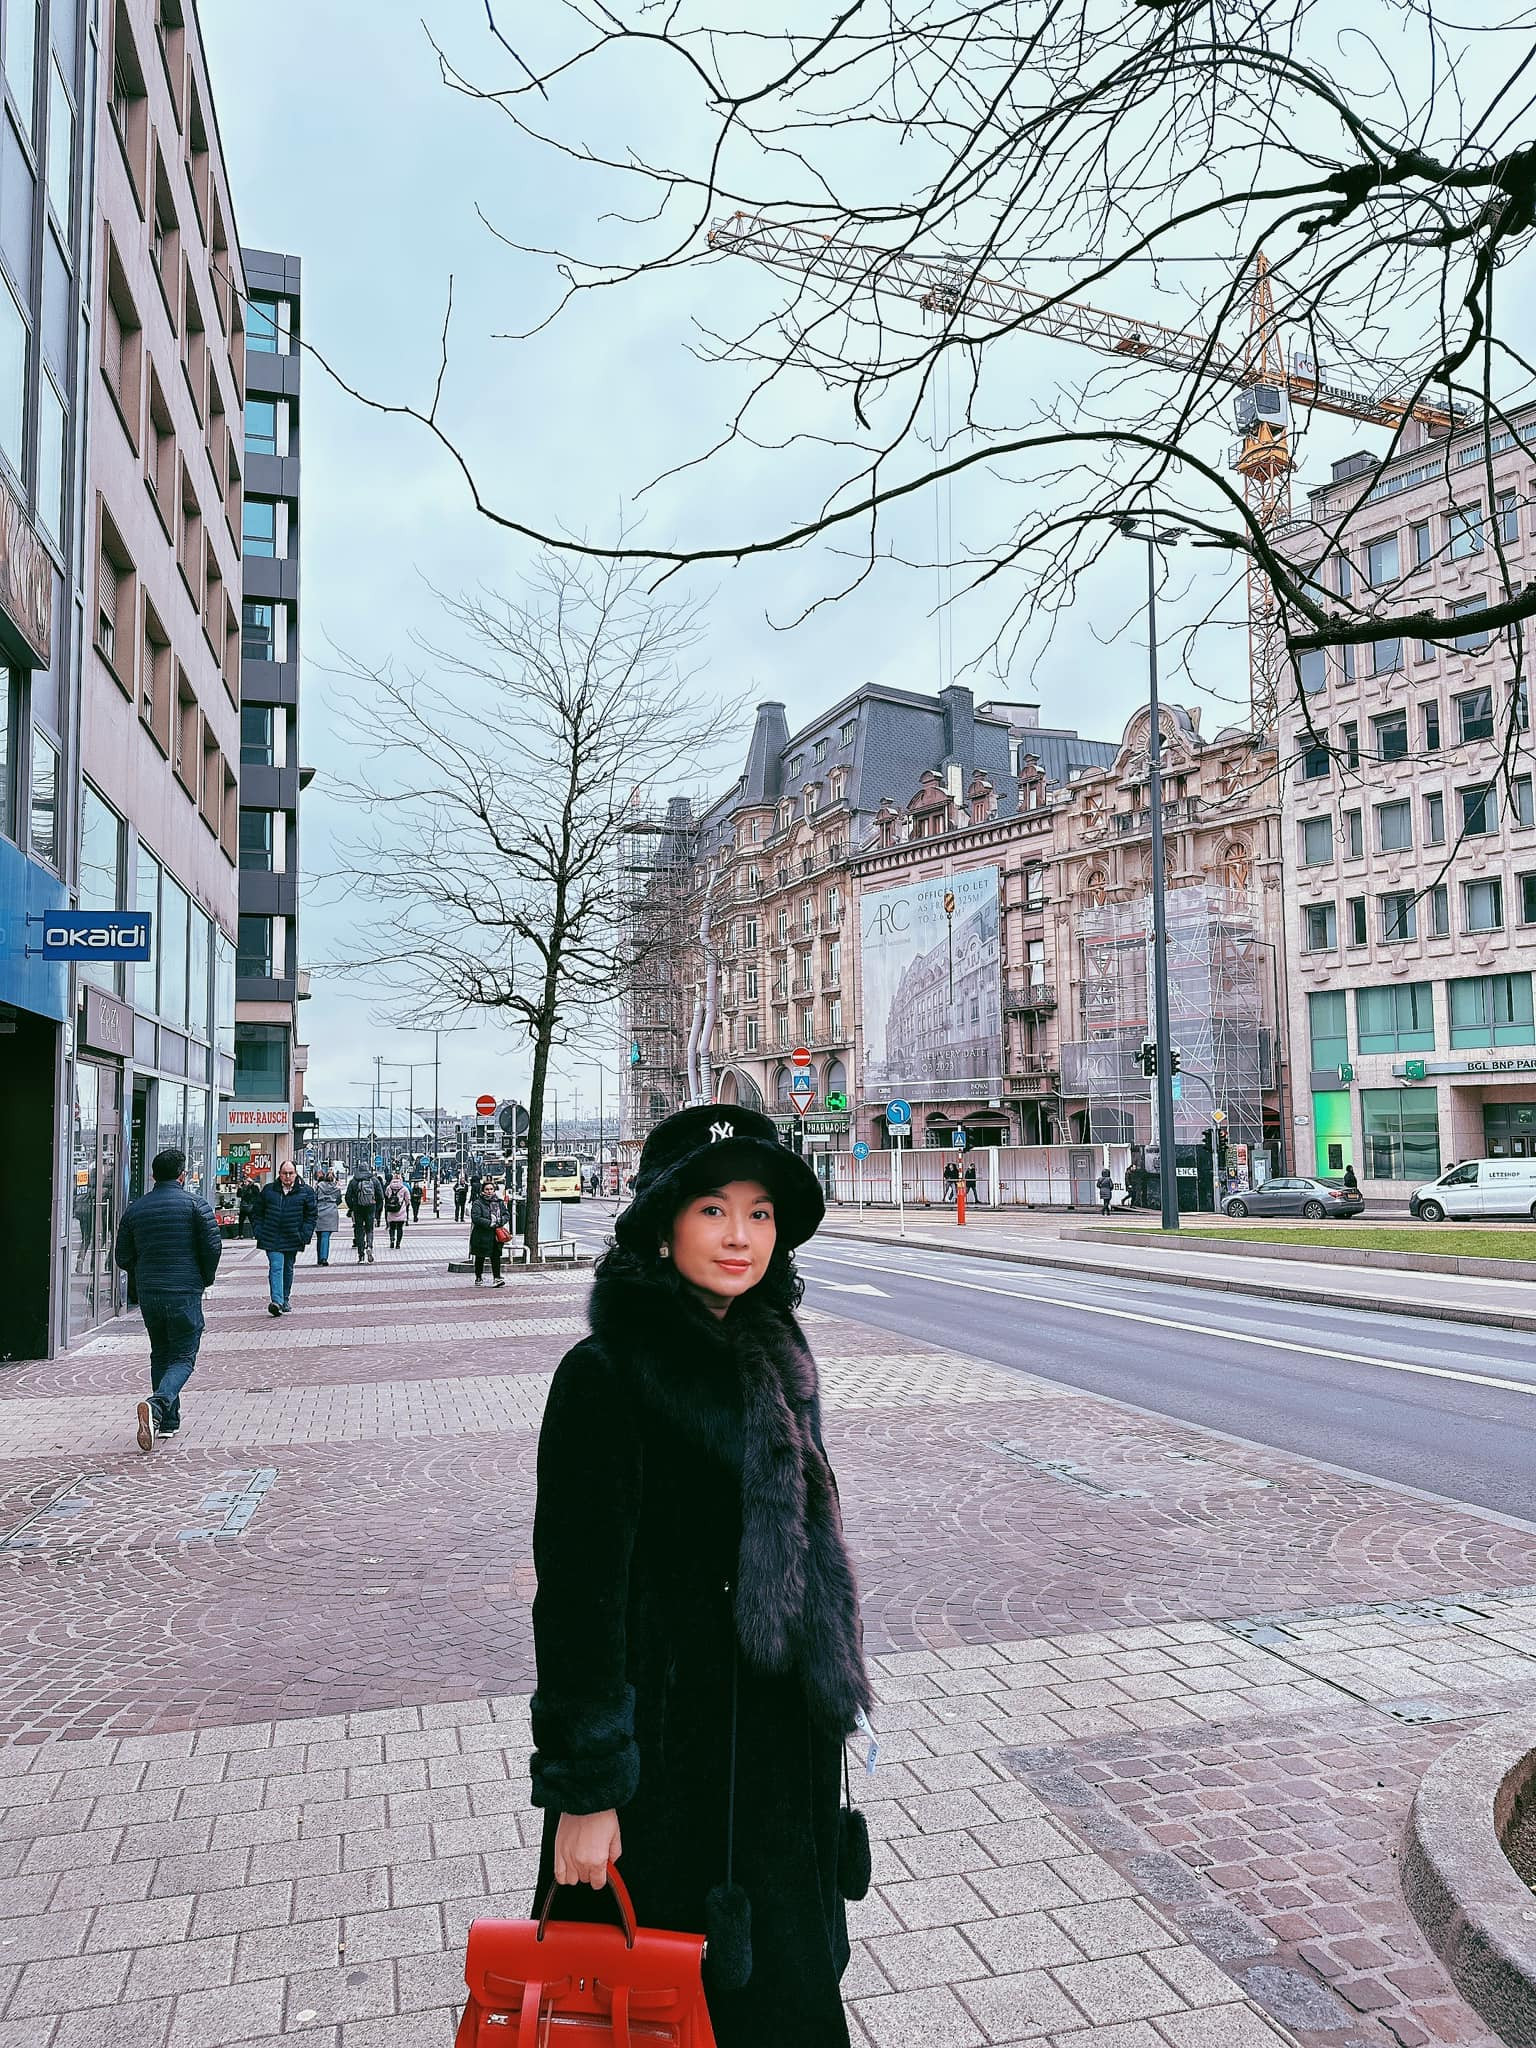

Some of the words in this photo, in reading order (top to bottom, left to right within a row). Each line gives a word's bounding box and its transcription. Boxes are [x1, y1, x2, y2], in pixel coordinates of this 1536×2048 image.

[957, 884, 970, 893] TO
[973, 880, 989, 891] LET
[865, 899, 911, 938] ARC
[1467, 1062, 1489, 1071] BGL
[1492, 1060, 1514, 1070] BNP
[228, 1111, 288, 1124] WITRY-RAUSCH
[709, 1121, 734, 1144] NY
[807, 1121, 846, 1134] PHARMACIE
